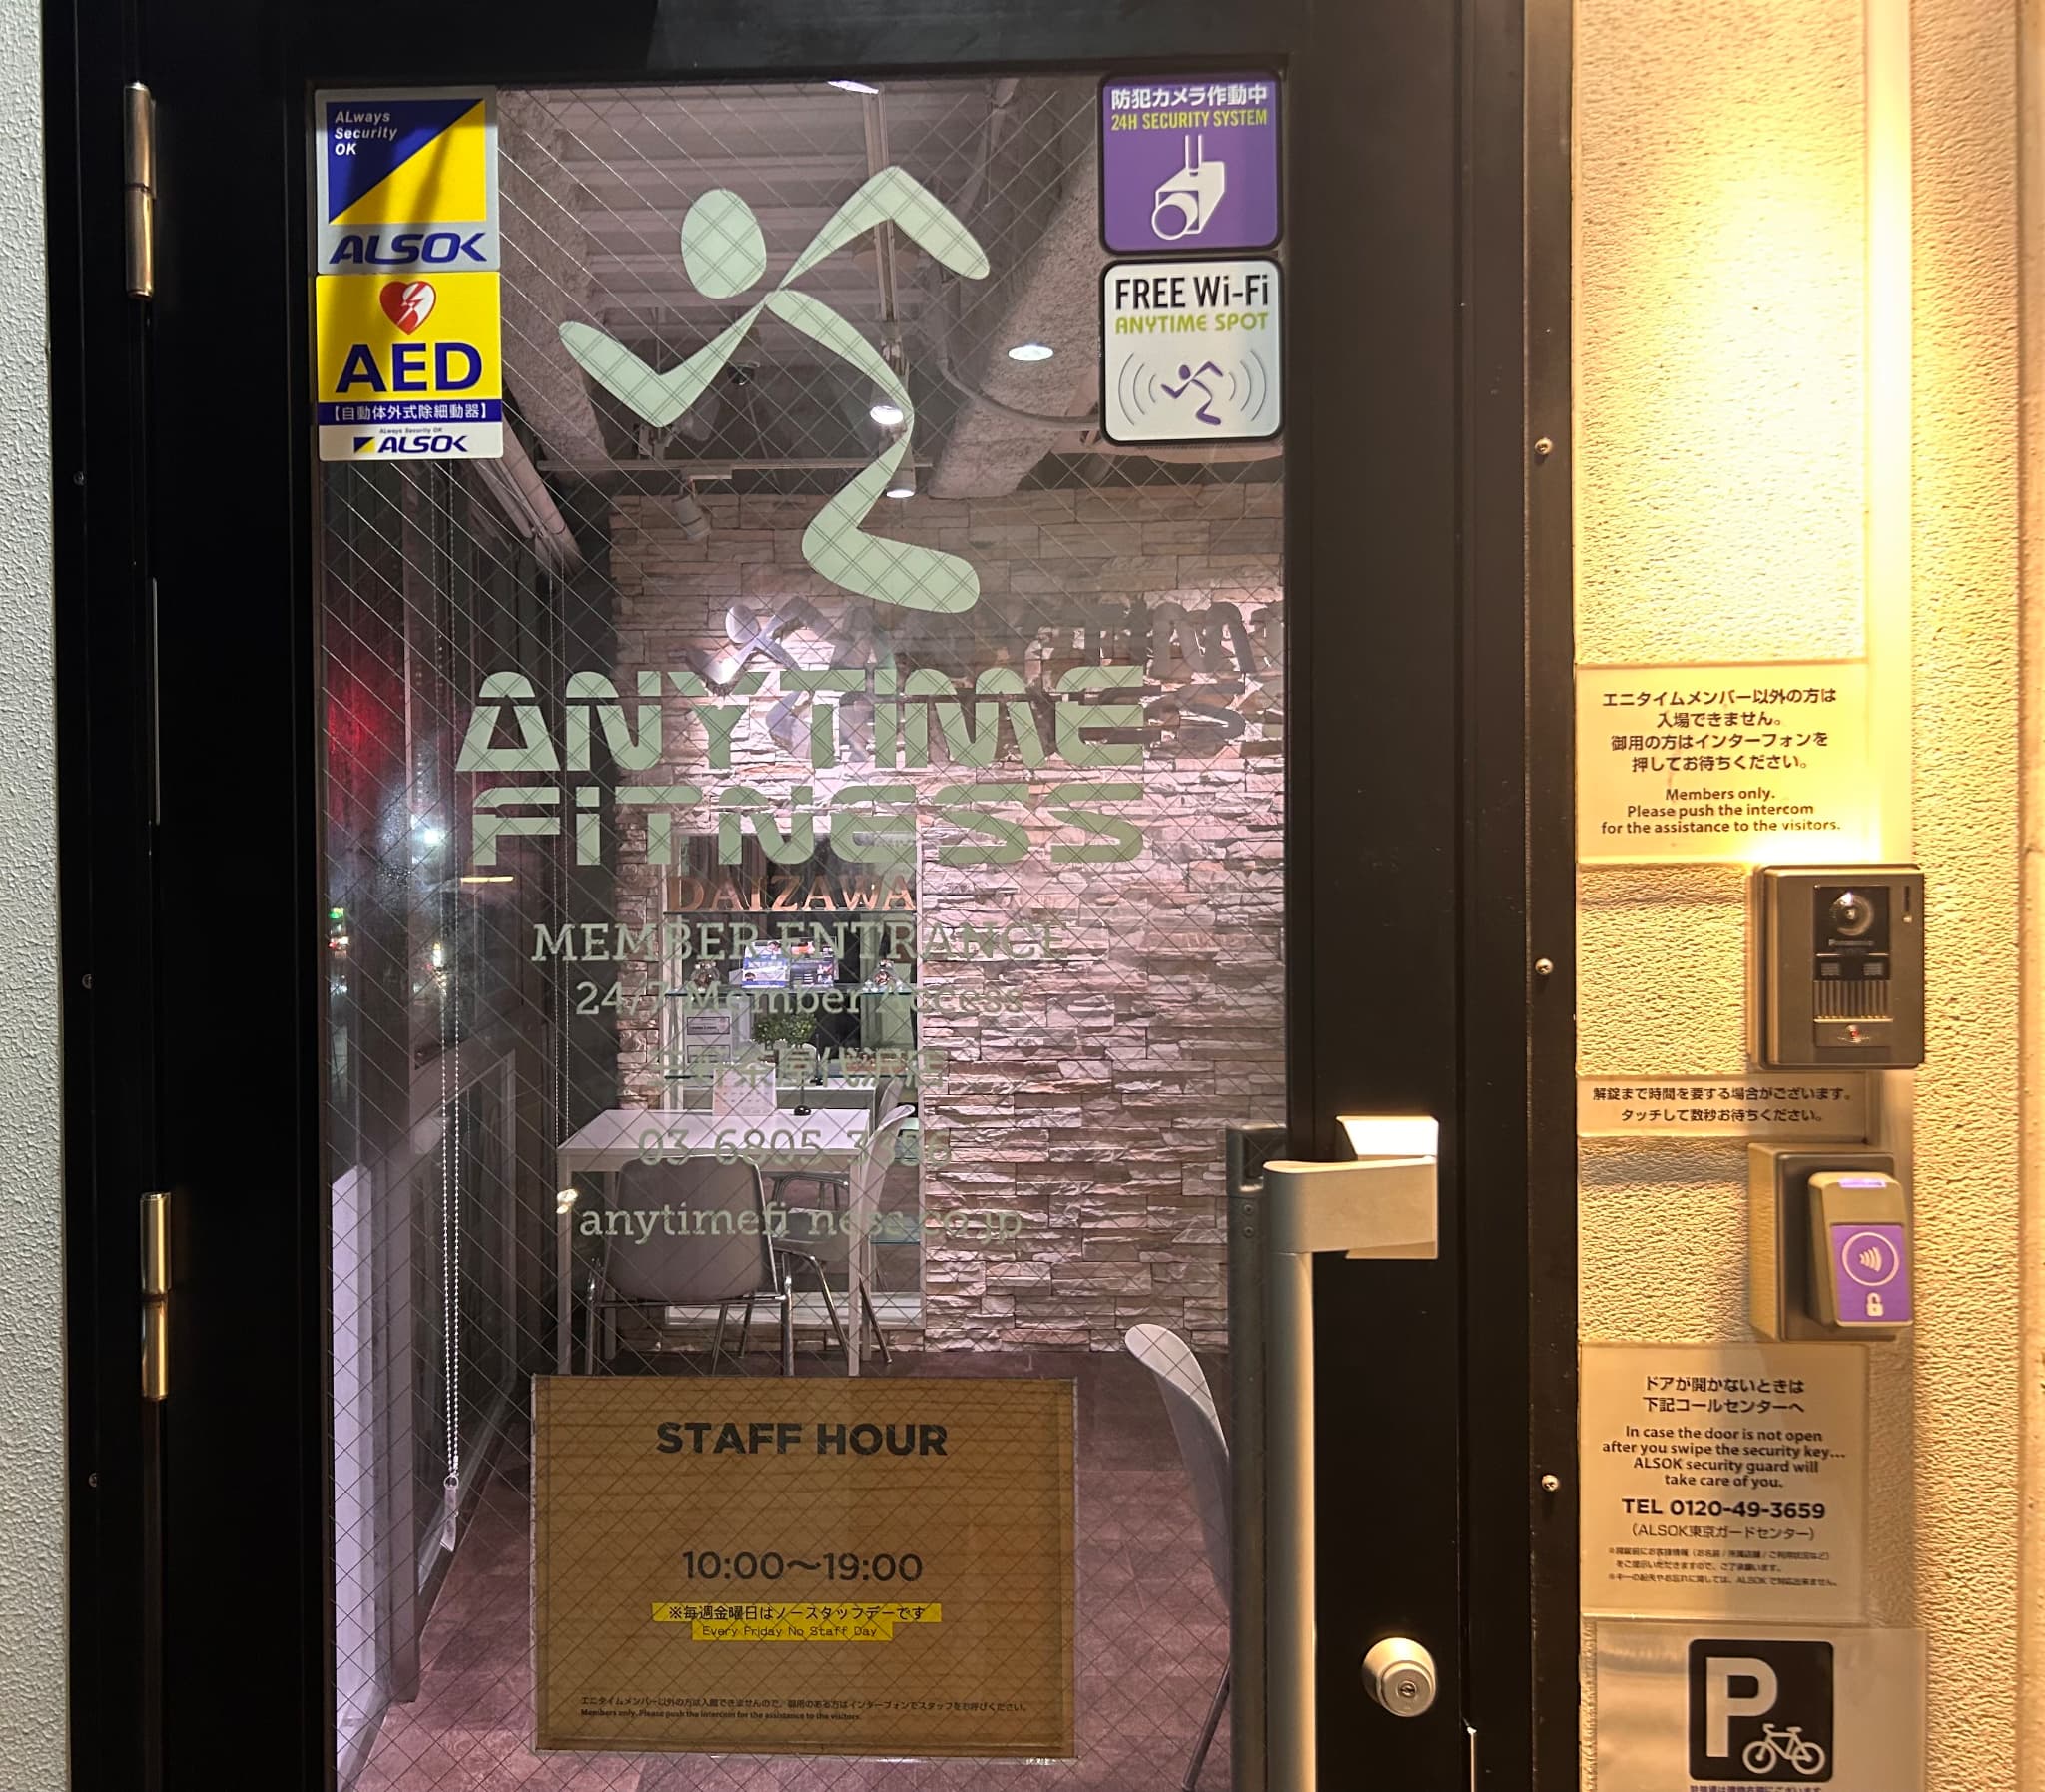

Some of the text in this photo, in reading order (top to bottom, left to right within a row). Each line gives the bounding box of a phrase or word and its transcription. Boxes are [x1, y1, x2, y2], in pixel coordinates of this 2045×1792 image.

[1111, 84, 1268, 110] 防犯カメラ作動中
[334, 111, 391, 124] ALways
[1111, 108, 1268, 131] 24H SECURITY SYSTEM
[334, 126, 398, 141] Security
[334, 143, 357, 156] OK
[329, 231, 488, 266] ALSOK
[1115, 274, 1269, 310] FREE Wi-Fi
[1114, 310, 1270, 335] ANYTIME SPOT
[335, 341, 483, 394] AED
[377, 435, 468, 454] ALSOK
[1602, 687, 1837, 707] エニタイムメンバー以外の方は
[455, 665, 1144, 771] ANYTIME
[1657, 711, 1782, 729] 入場できません。
[1611, 731, 1828, 752] 御用の方はインターフォンを
[1631, 754, 1807, 773] 押してお待ちください。
[1665, 787, 1776, 803] Members only.
[1627, 803, 1814, 820] Please push the intercom
[1601, 819, 1841, 835] for the assistance to the visitors.
[666, 874, 917, 911] DAIZAWA
[531, 921, 1068, 961] MEMBER ENTRANCE
[576, 980, 671, 1016] 24/7
[682, 980, 862, 1014] Member
[1592, 1086, 1852, 1101] 解錠まで時間を要する場合がございます。
[1621, 1108, 1823, 1122] タッチして数秒お待ちください。
[638, 1128, 689, 1166] 03
[714, 1128, 822, 1166] 6805
[1645, 1376, 1805, 1394] ドアが開かないときは
[1643, 1397, 1805, 1414] 下記コールセンターへ
[655, 1421, 949, 1457] STAFF HOUR
[1625, 1426, 1822, 1445] In case the door is not open
[1602, 1441, 1637, 1453] after
[1640, 1444, 1668, 1457] you
[1671, 1444, 1712, 1458] swipe
[1715, 1444, 1739, 1456] the
[1742, 1444, 1800, 1459] security
[1633, 1458, 1819, 1475] ALSOK security guard will
[1665, 1474, 1783, 1490] take care of you.
[1621, 1497, 1826, 1519] TEL 0120-49-3659
[702, 1625, 878, 1638] Every Friday No Staff Day
[580, 1708, 617, 1717] Members
[1705, 1656, 1778, 1758] P
